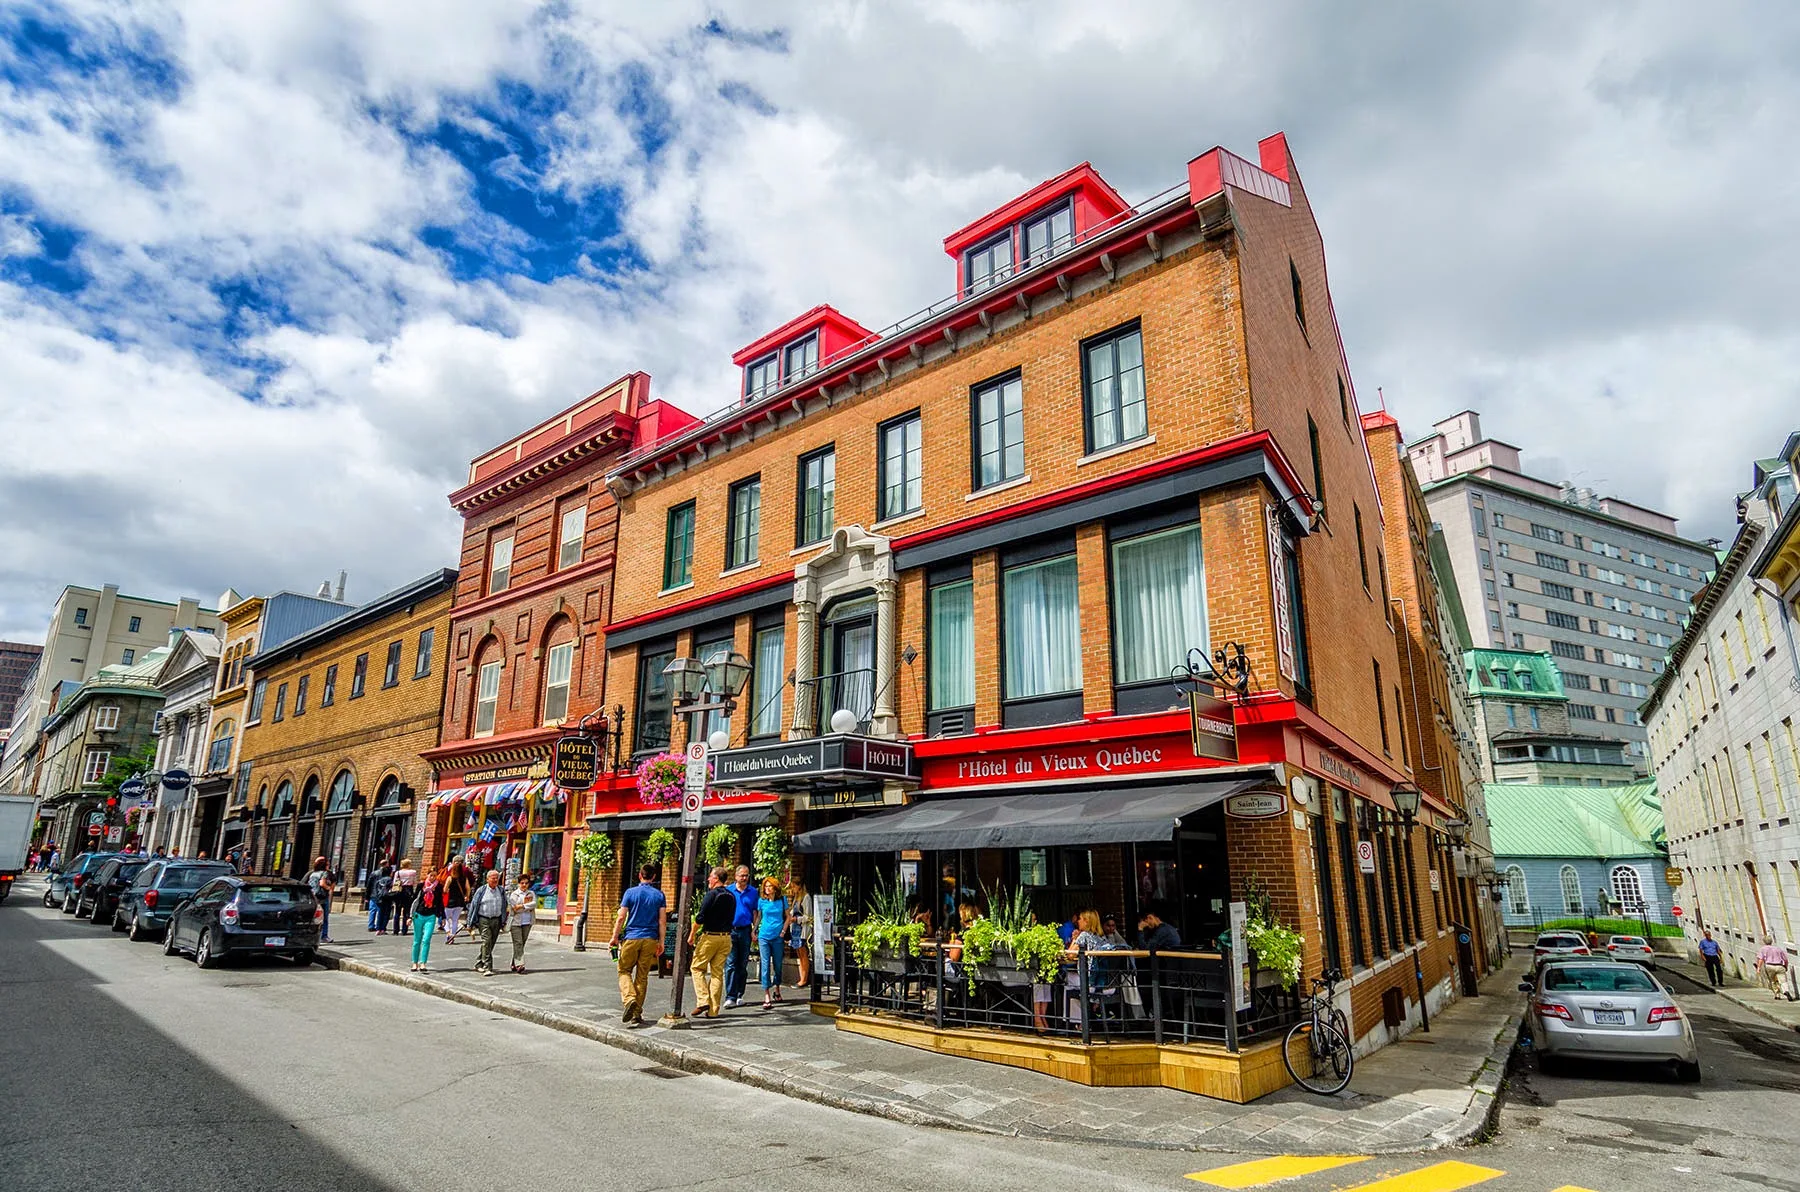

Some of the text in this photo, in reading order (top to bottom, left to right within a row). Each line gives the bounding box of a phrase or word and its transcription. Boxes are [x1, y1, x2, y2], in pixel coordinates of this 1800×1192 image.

[1198, 717, 1234, 736] TOURNEBROCHE
[560, 742, 595, 755] HÔTEL
[561, 760, 592, 770] VIEUX-
[750, 758, 760, 770] du
[760, 758, 782, 769] Vieux
[868, 750, 904, 767] HÔTEL
[958, 746, 1162, 779] l'Hôtel du Vieux Québec
[465, 770, 496, 782] STATION
[497, 766, 528, 778] CADEAU
[557, 769, 594, 781] QUÉBEC
[834, 791, 856, 804] 1190
[1237, 800, 1273, 808] Saint-Jean
